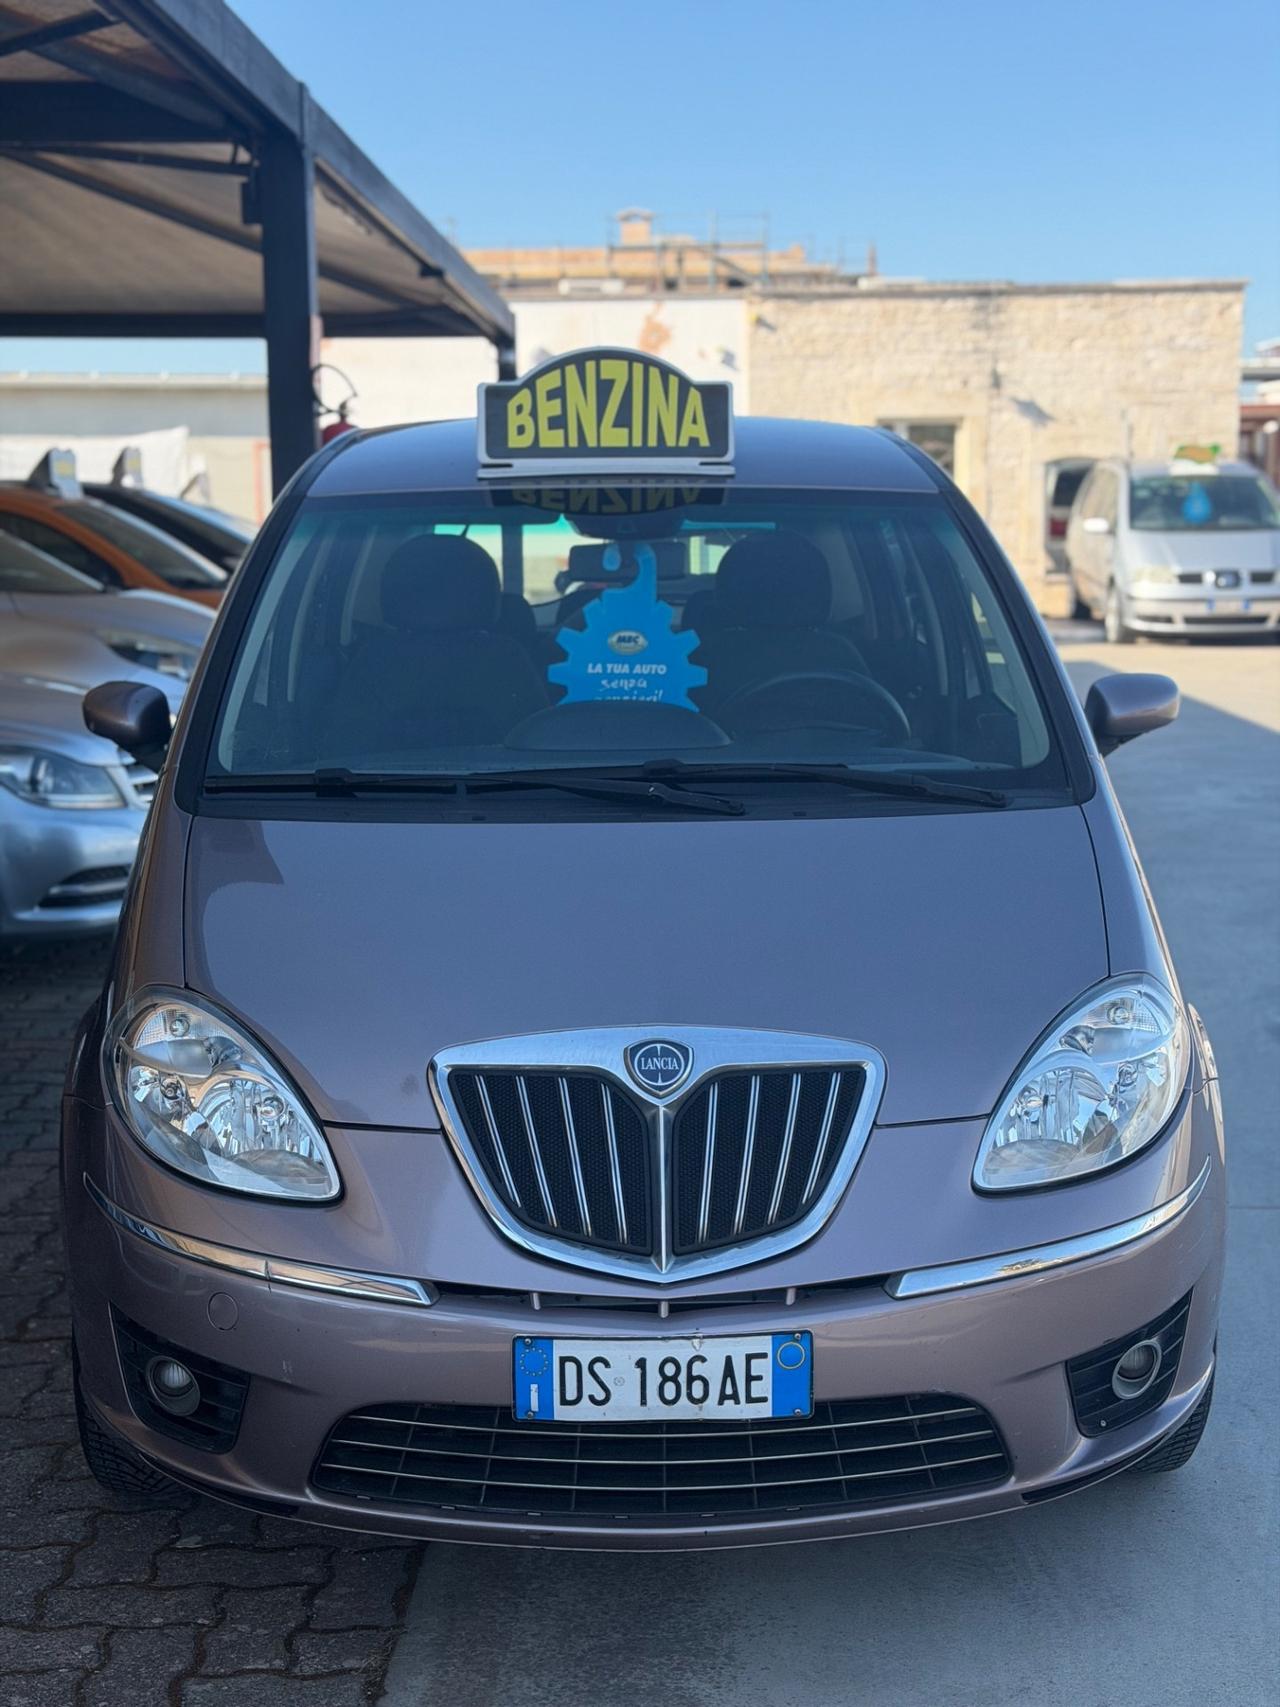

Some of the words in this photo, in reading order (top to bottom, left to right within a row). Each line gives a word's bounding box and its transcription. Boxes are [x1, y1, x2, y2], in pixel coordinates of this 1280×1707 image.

[507, 359, 710, 448] BENZINA
[587, 662, 602, 674] LA
[606, 663, 630, 674] TUA
[633, 663, 667, 675] AUTO
[640, 1057, 679, 1070] LANCIA
[559, 1355, 612, 1407] DS
[634, 1352, 769, 1407] 186AE
